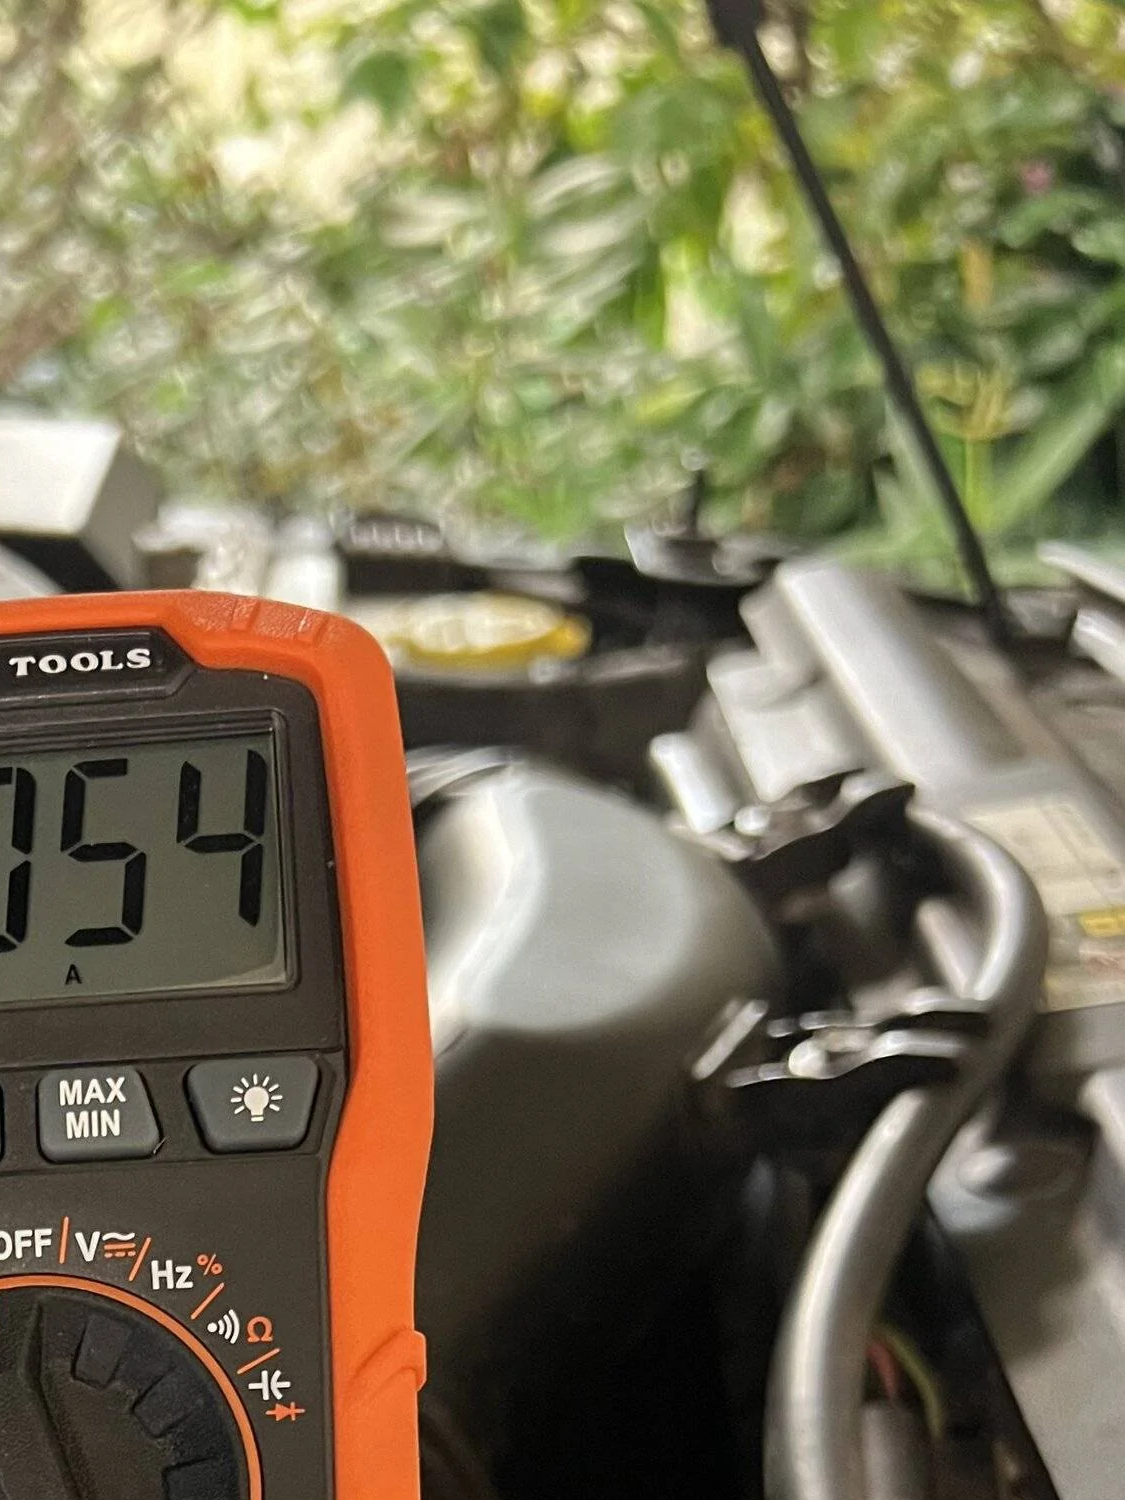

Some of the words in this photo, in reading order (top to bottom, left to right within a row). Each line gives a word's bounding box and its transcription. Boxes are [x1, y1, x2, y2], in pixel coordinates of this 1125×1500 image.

[8, 647, 152, 677] TOOLS
[65, 964, 82, 985] A
[59, 1077, 126, 1105] MAX
[66, 1109, 121, 1139] MIN
[151, 1261, 193, 1290] Hz
